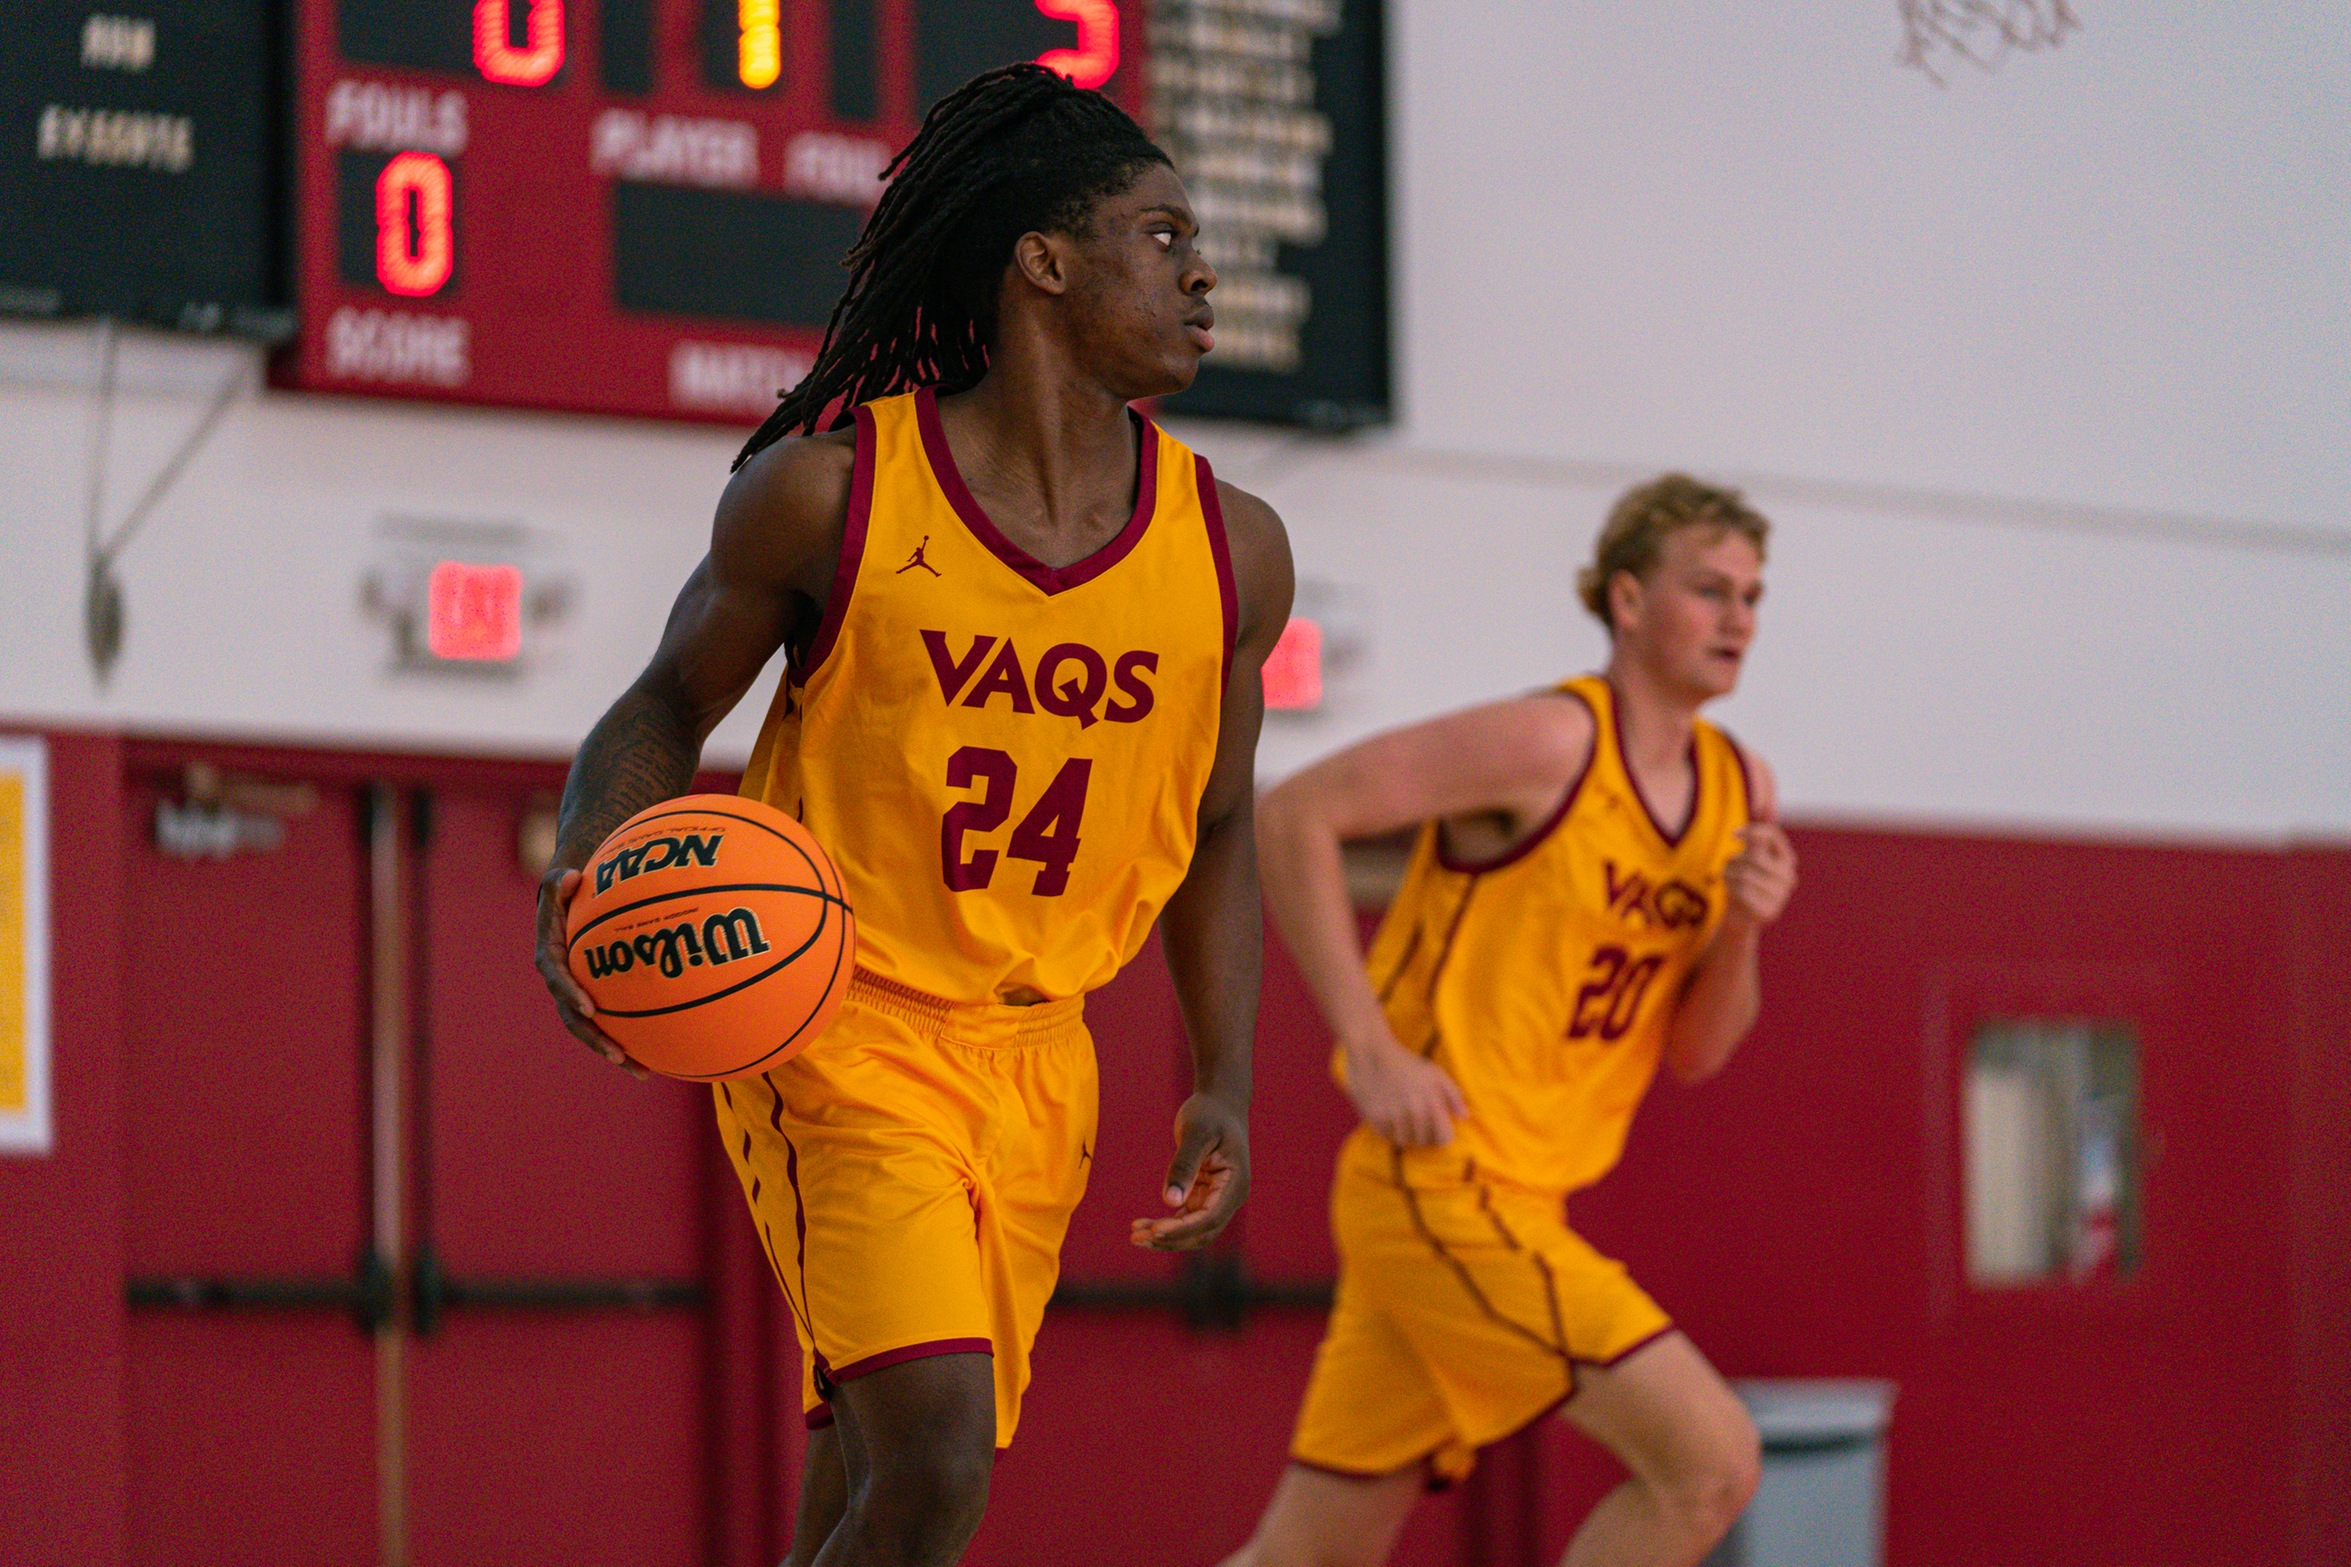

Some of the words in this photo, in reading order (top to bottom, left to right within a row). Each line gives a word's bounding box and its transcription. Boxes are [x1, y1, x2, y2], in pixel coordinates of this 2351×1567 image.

[325, 79, 469, 157] FOULS
[589, 107, 759, 187] PLAYER
[376, 151, 453, 298] 0
[325, 306, 472, 389] SCORE
[919, 629, 1159, 730] VAQS
[941, 745, 1093, 897] 24
[594, 833, 725, 898] NCAA
[584, 906, 771, 979] Wilson
[1566, 944, 1664, 1041] 20
